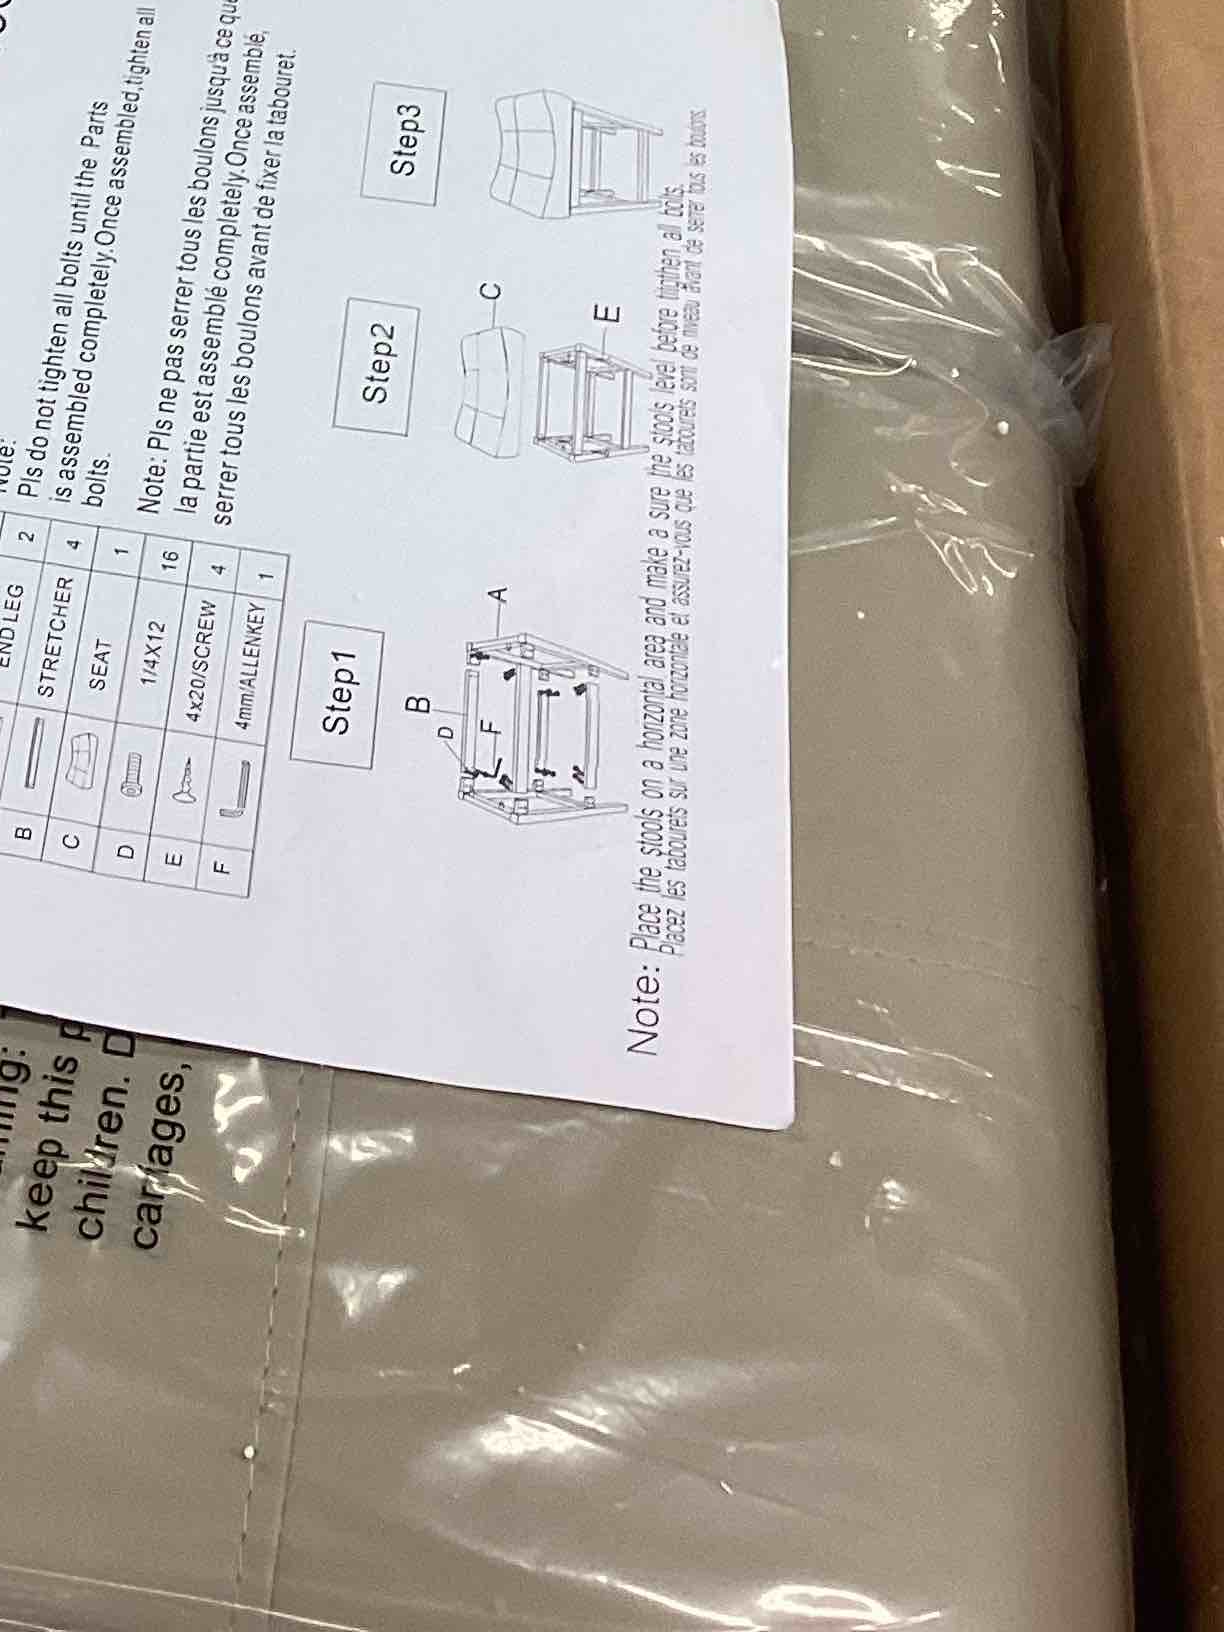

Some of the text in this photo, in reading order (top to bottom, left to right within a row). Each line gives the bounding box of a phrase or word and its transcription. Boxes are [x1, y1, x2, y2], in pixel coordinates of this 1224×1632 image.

[135, 7, 156, 26] all
[215, 27, 234, 50] ce
[186, 115, 220, 191] boulons
[391, 103, 424, 177] Step3
[180, 195, 208, 225] les
[657, 183, 684, 218] bolts.
[175, 228, 203, 272] tous
[656, 223, 683, 242] all
[16, 100, 109, 498] Pls do not tighten all bolts until the Parts
[213, 49, 297, 527] serrer tous les boulons avant de fixer la tabouret.
[478, 281, 502, 301] C
[169, 276, 195, 340] serrer
[594, 303, 621, 324] E
[197, 285, 228, 387] assemblé
[649, 307, 679, 353] before
[162, 343, 187, 384] pas
[361, 322, 396, 405] Step2
[647, 357, 677, 395] level
[157, 387, 179, 414] ne
[191, 390, 214, 424] est
[58, 367, 93, 481] assembled
[146, 418, 174, 452] Pls
[651, 401, 678, 446] stools
[182, 428, 209, 492] partie
[644, 454, 676, 480] the
[47, 486, 73, 504] is
[80, 452, 112, 509] bolts.
[135, 456, 168, 515] Note:
[172, 495, 199, 515] la
[648, 486, 672, 521] sure
[17, 530, 35, 543] 2
[65, 539, 81, 551] 4
[647, 527, 670, 540] a
[113, 547, 129, 557] 1
[161, 550, 180, 572] 16
[641, 546, 669, 590] make
[209, 564, 227, 576] 4
[258, 573, 273, 581] 1
[0, 583, 24, 624] LEG
[486, 586, 508, 605] A
[639, 595, 672, 627] and
[37, 576, 74, 698] STRETCHER
[139, 620, 165, 687] 1/4X12
[643, 633, 671, 669] area
[88, 638, 112, 692] SEAT
[185, 599, 217, 723] 4x20/SCREW
[235, 601, 266, 731] 4mm/ALLENKEY
[322, 648, 358, 737] Step1
[404, 696, 431, 713] B
[479, 719, 502, 735] F
[635, 674, 669, 752] horizontal
[437, 726, 455, 741] D
[641, 759, 665, 771] a
[640, 778, 665, 800] on
[14, 826, 33, 841] B
[62, 833, 80, 850] C
[632, 807, 665, 858] stools
[116, 844, 135, 860] D
[165, 852, 183, 868] E
[213, 861, 232, 876] F
[631, 866, 663, 898] the
[628, 903, 662, 953] Place
[625, 964, 661, 1057] Note:
[37, 1054, 80, 1125] this
[72, 1075, 132, 1241] children.
[133, 1062, 194, 1251] cariages,
[15, 1138, 70, 1233] keep
